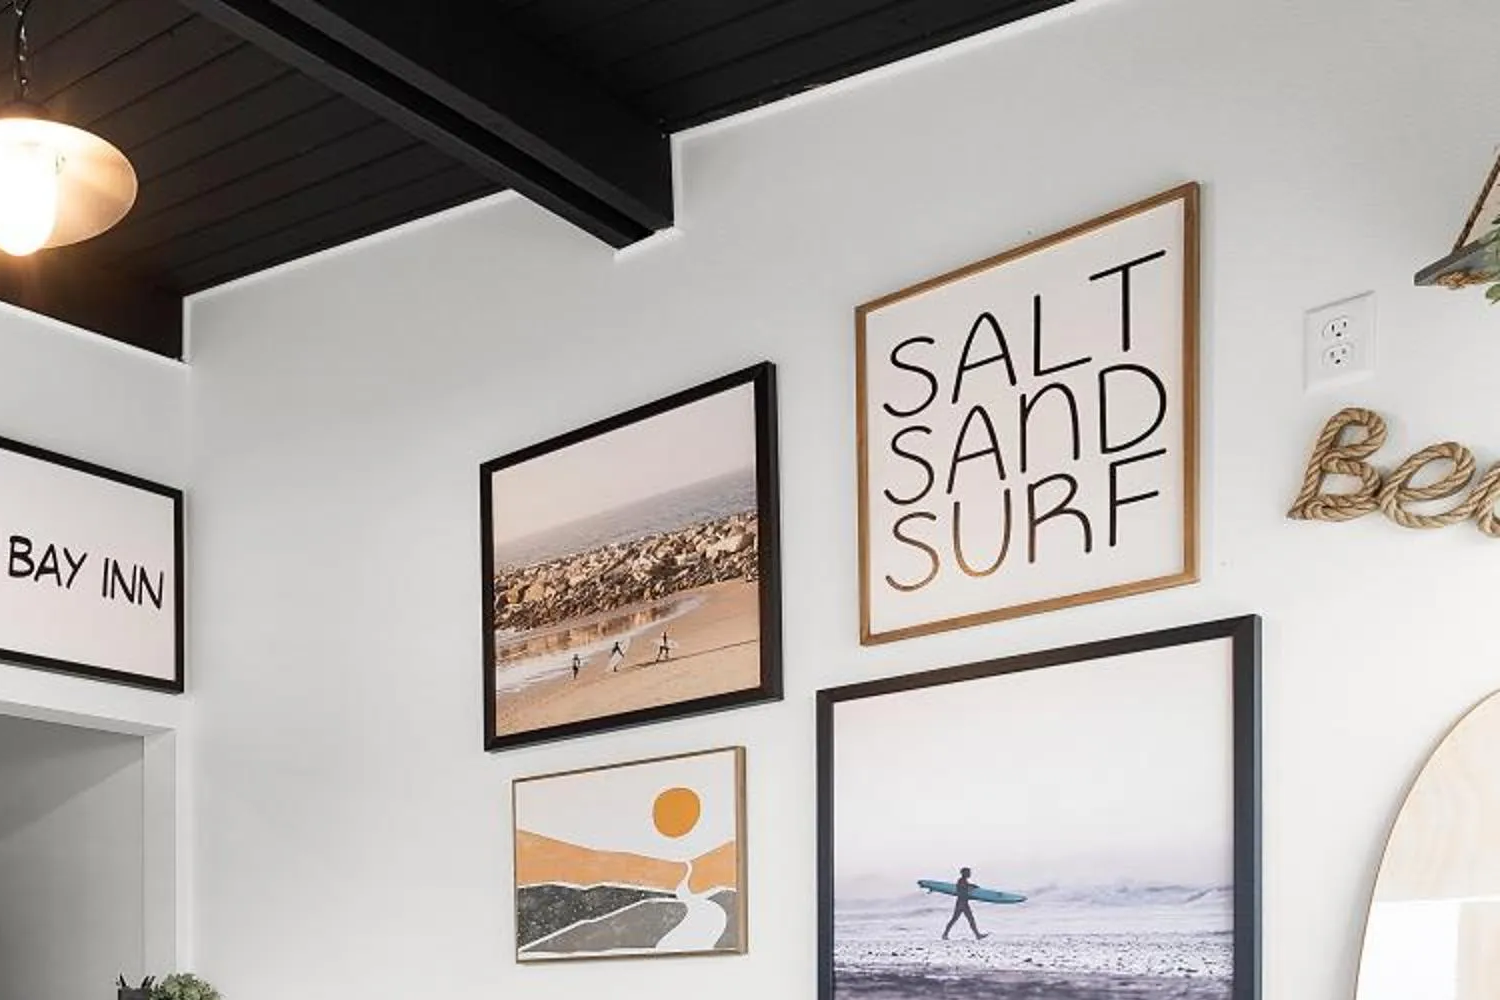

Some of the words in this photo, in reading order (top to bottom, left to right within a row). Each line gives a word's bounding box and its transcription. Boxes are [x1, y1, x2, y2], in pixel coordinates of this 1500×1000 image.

[882, 249, 1167, 419] SALT
[8, 535, 88, 590] BAY
[101, 557, 165, 610] INN
[884, 447, 1168, 592] SURF
